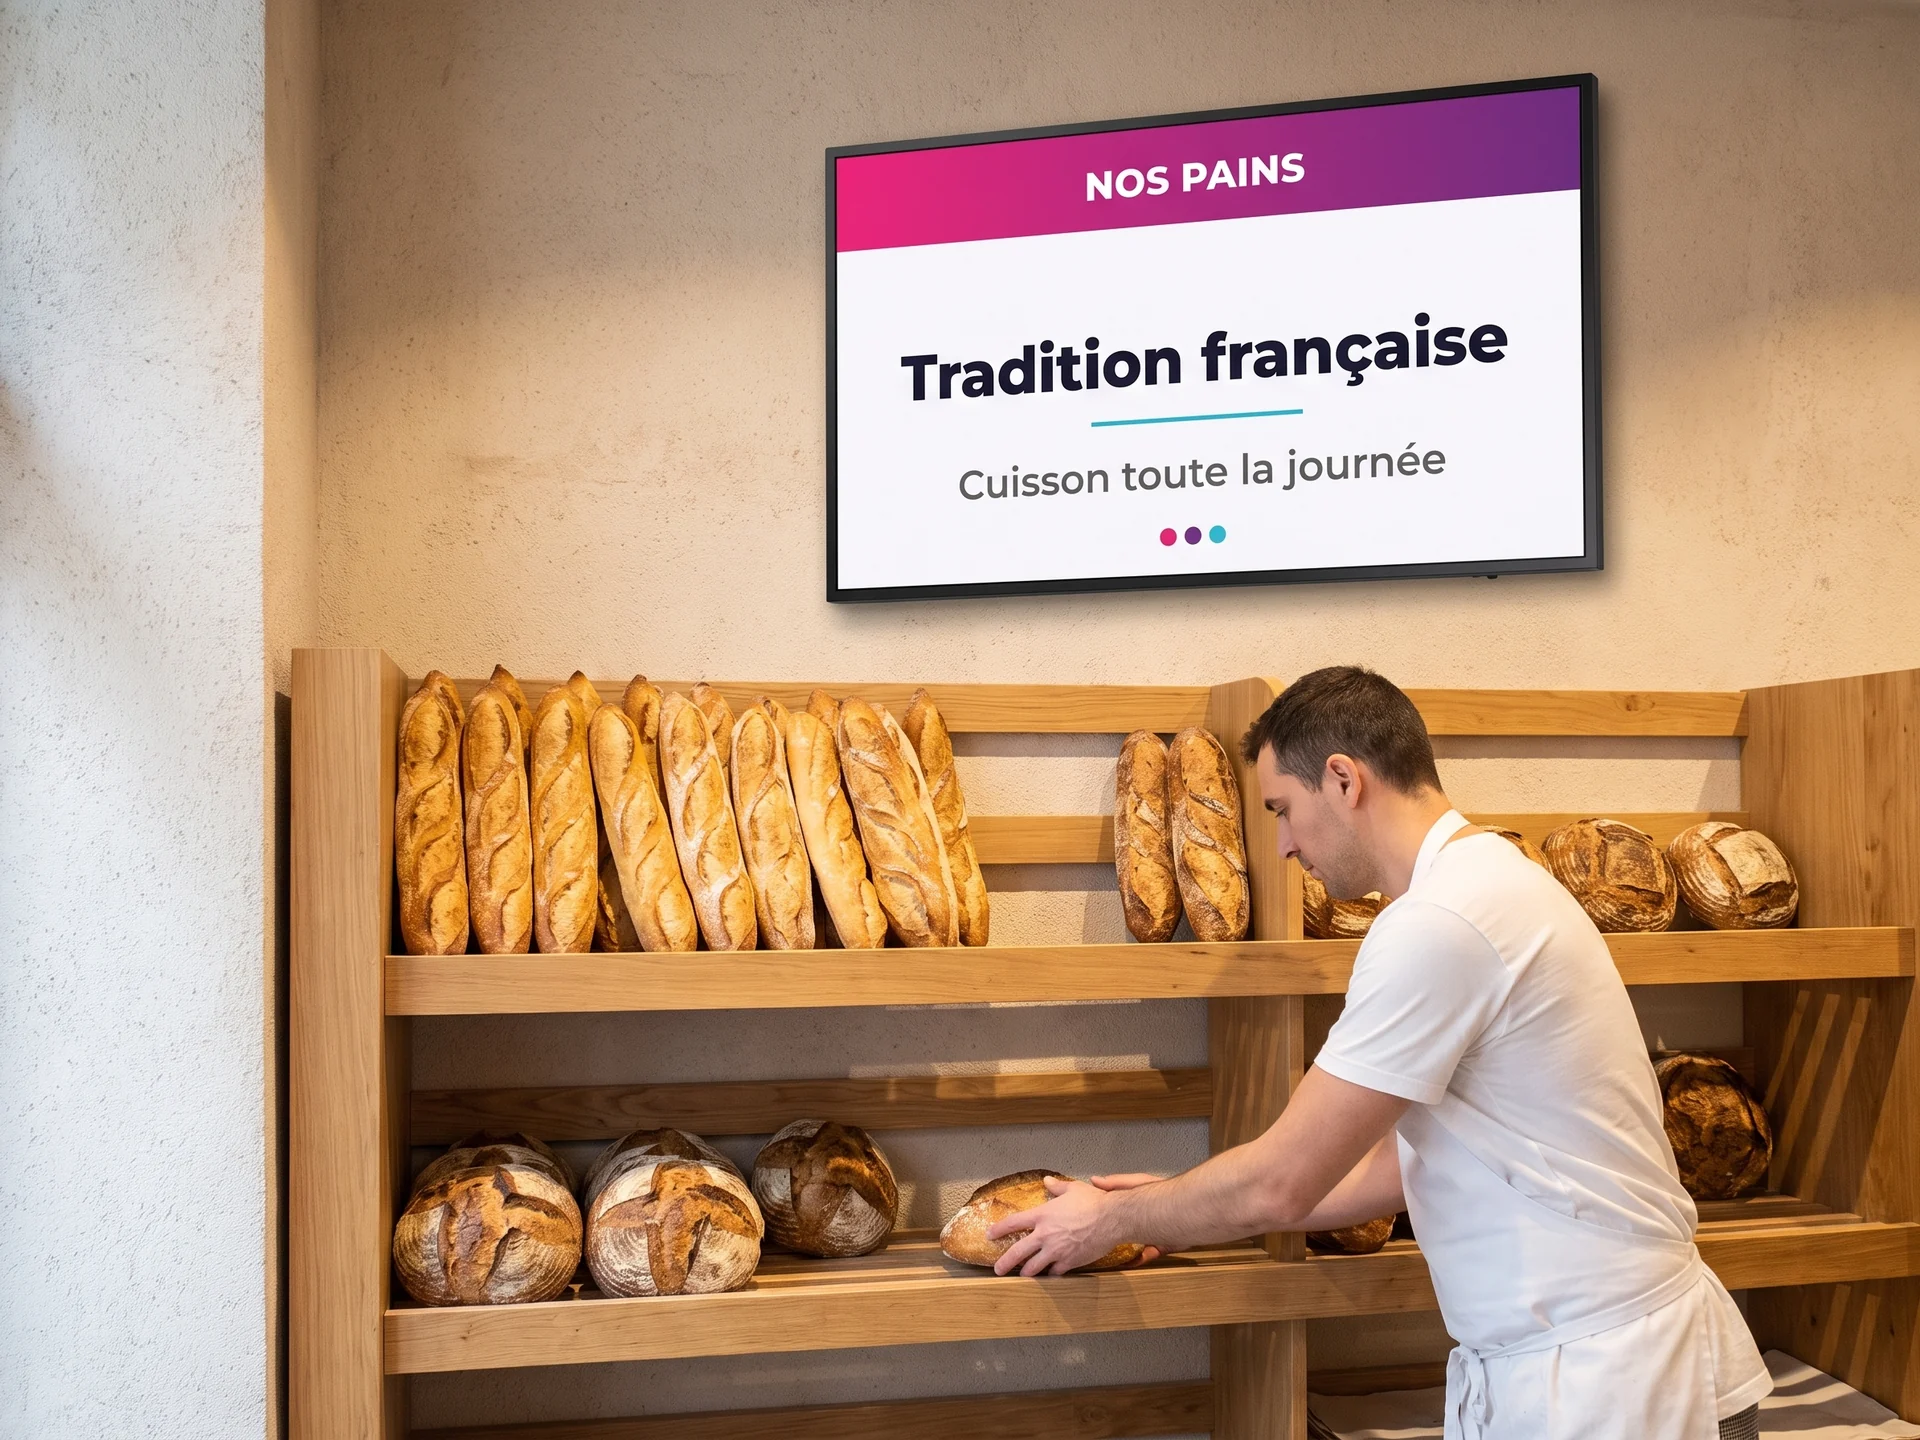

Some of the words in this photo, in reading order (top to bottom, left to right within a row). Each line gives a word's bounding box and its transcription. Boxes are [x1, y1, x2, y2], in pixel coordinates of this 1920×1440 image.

[1086, 165, 1170, 202] NOS
[1182, 152, 1305, 192] PAINS
[900, 336, 1182, 402] Tradition
[1200, 313, 1508, 387] française
[959, 464, 1109, 501] Cuisson
[1121, 459, 1228, 492] toute
[1242, 452, 1273, 485] la
[1281, 441, 1446, 491] journée
